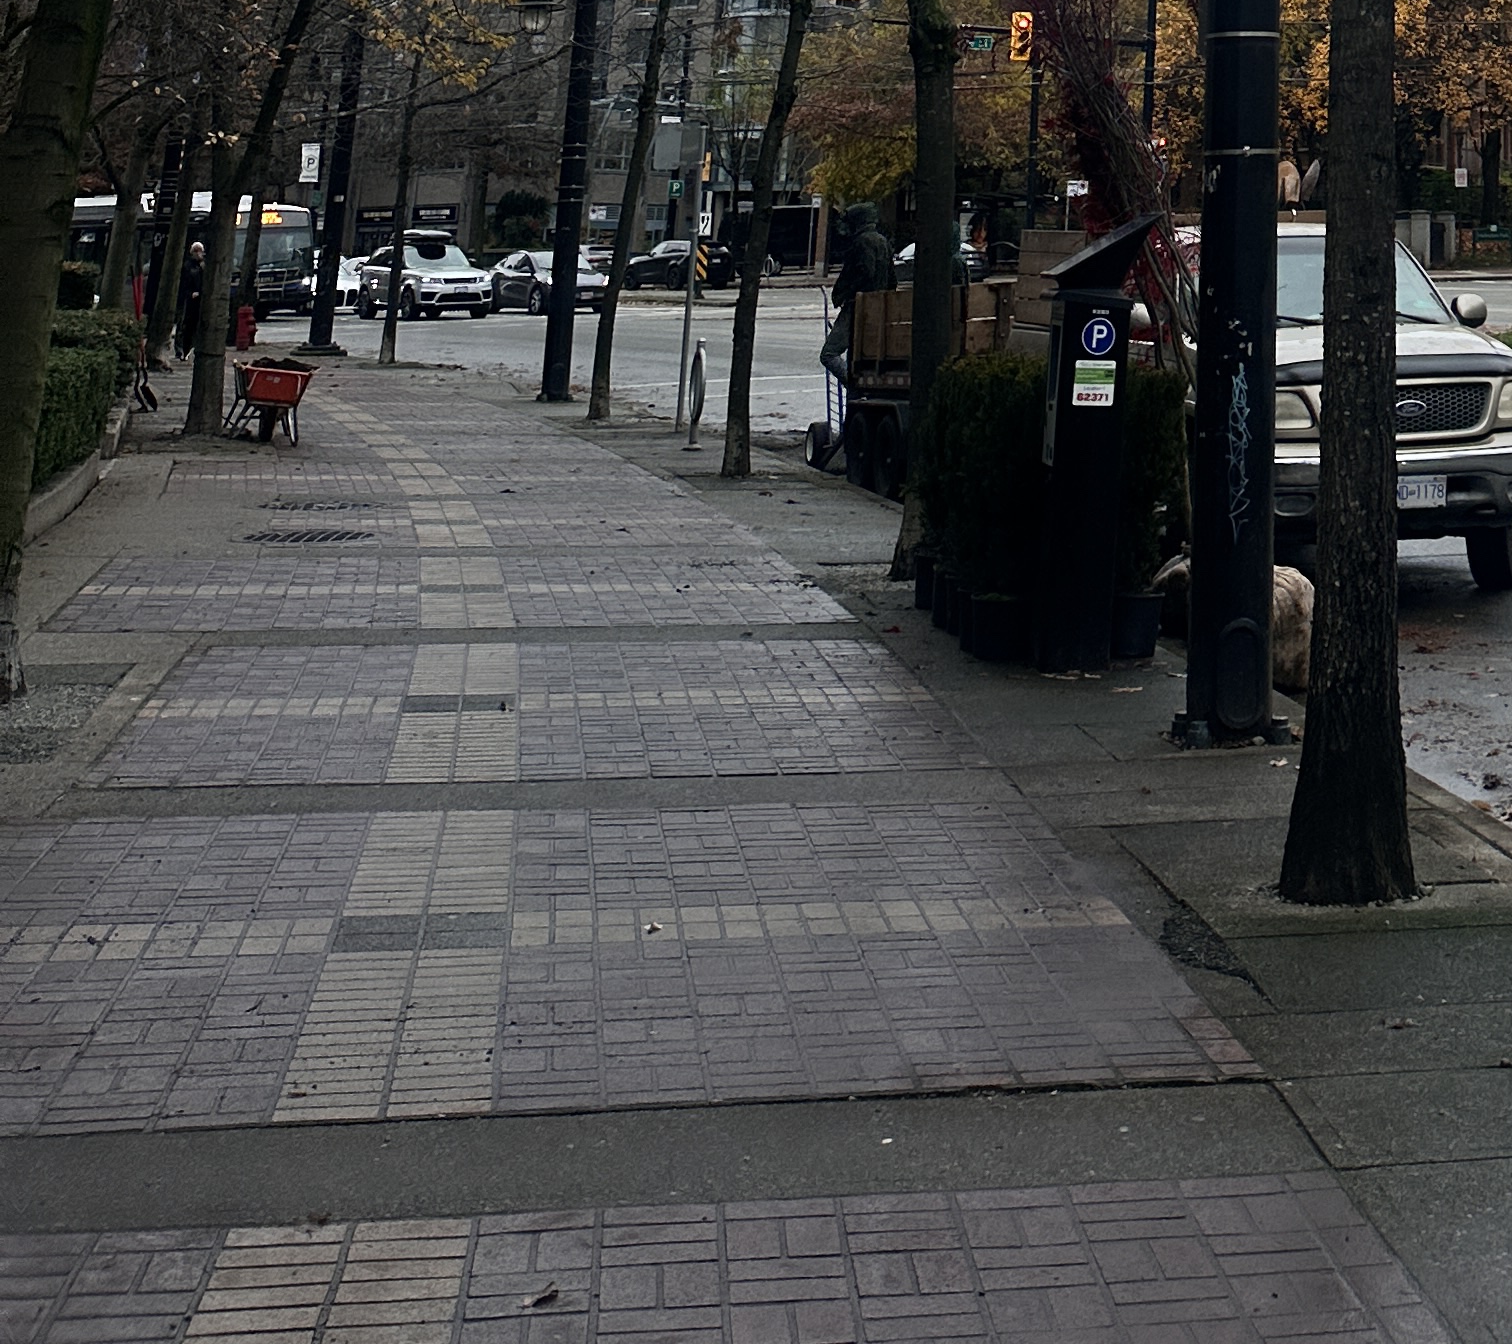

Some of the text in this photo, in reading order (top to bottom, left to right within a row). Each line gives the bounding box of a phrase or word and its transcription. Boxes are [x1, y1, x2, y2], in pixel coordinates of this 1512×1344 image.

[672, 183, 680, 192] P
[1092, 325, 1107, 348] P
[1077, 393, 1109, 402] 62371
